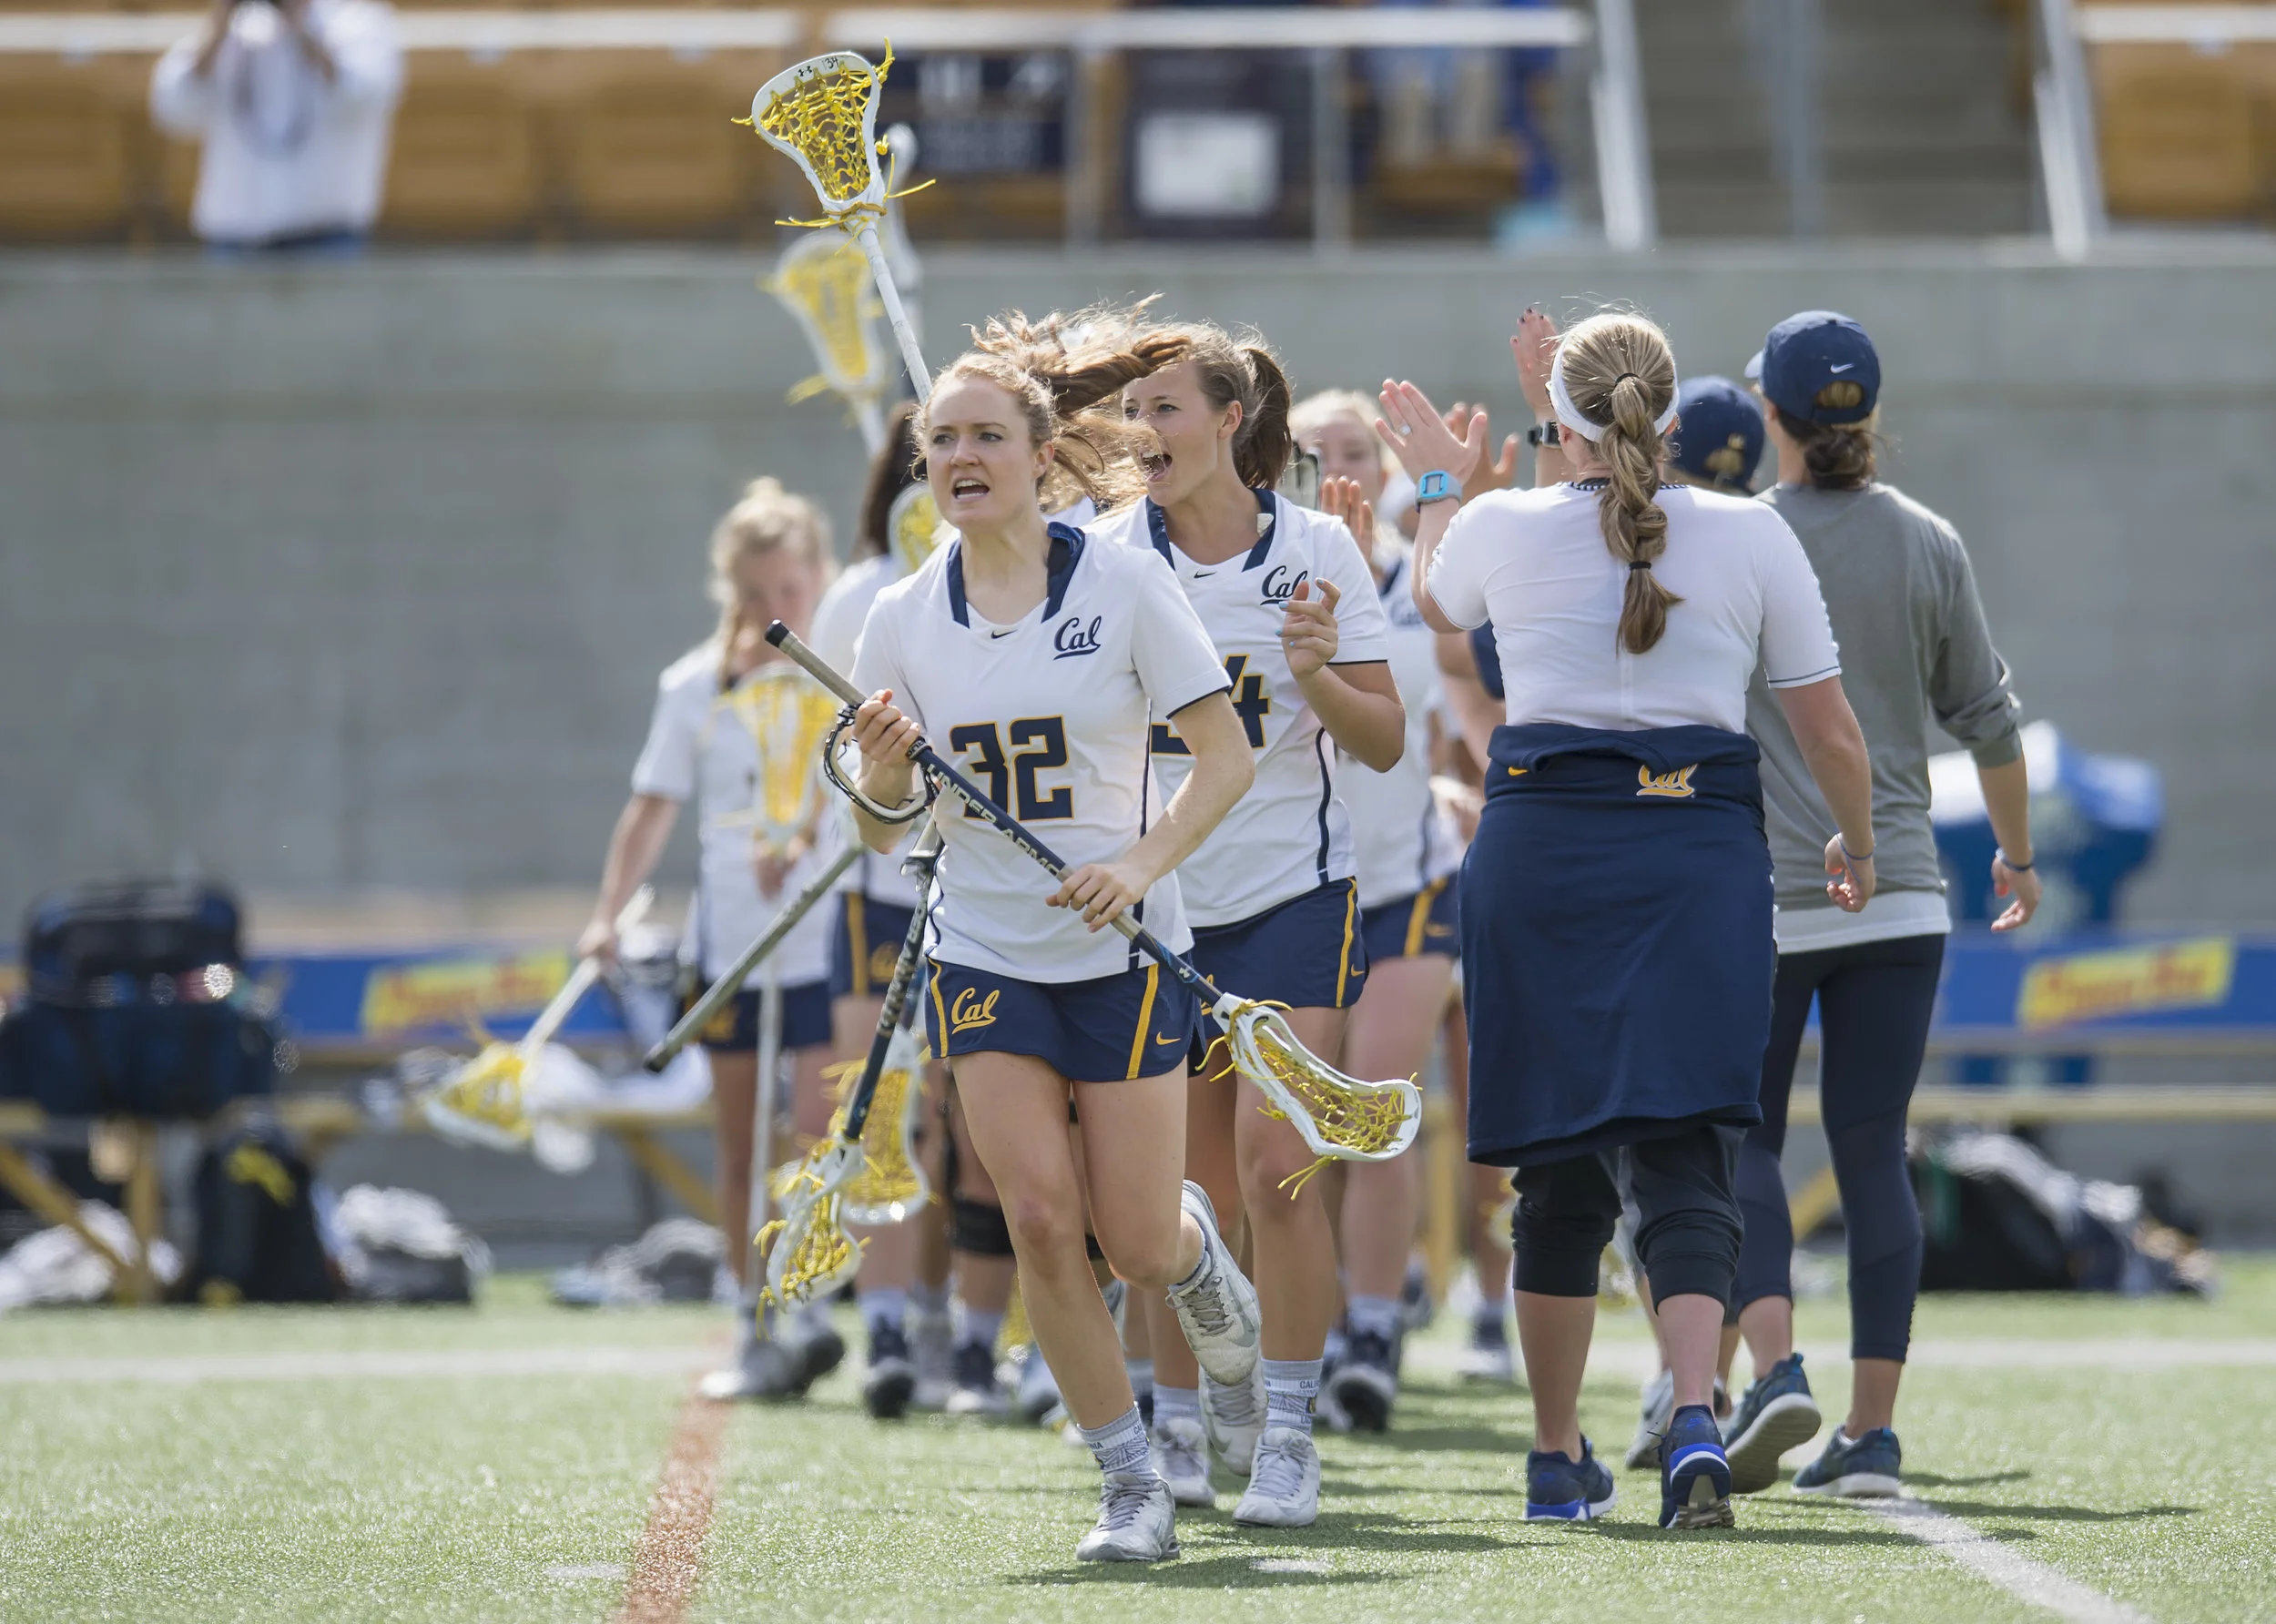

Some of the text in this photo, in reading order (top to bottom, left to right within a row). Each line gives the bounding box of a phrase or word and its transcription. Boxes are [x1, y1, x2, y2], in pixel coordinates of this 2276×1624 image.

[1260, 564, 1308, 606] Cal
[1053, 615, 1102, 661] Cal
[949, 714, 1075, 823] 32
[927, 763, 1061, 878] UNDER ARMO
[951, 987, 1001, 1035] Cal
